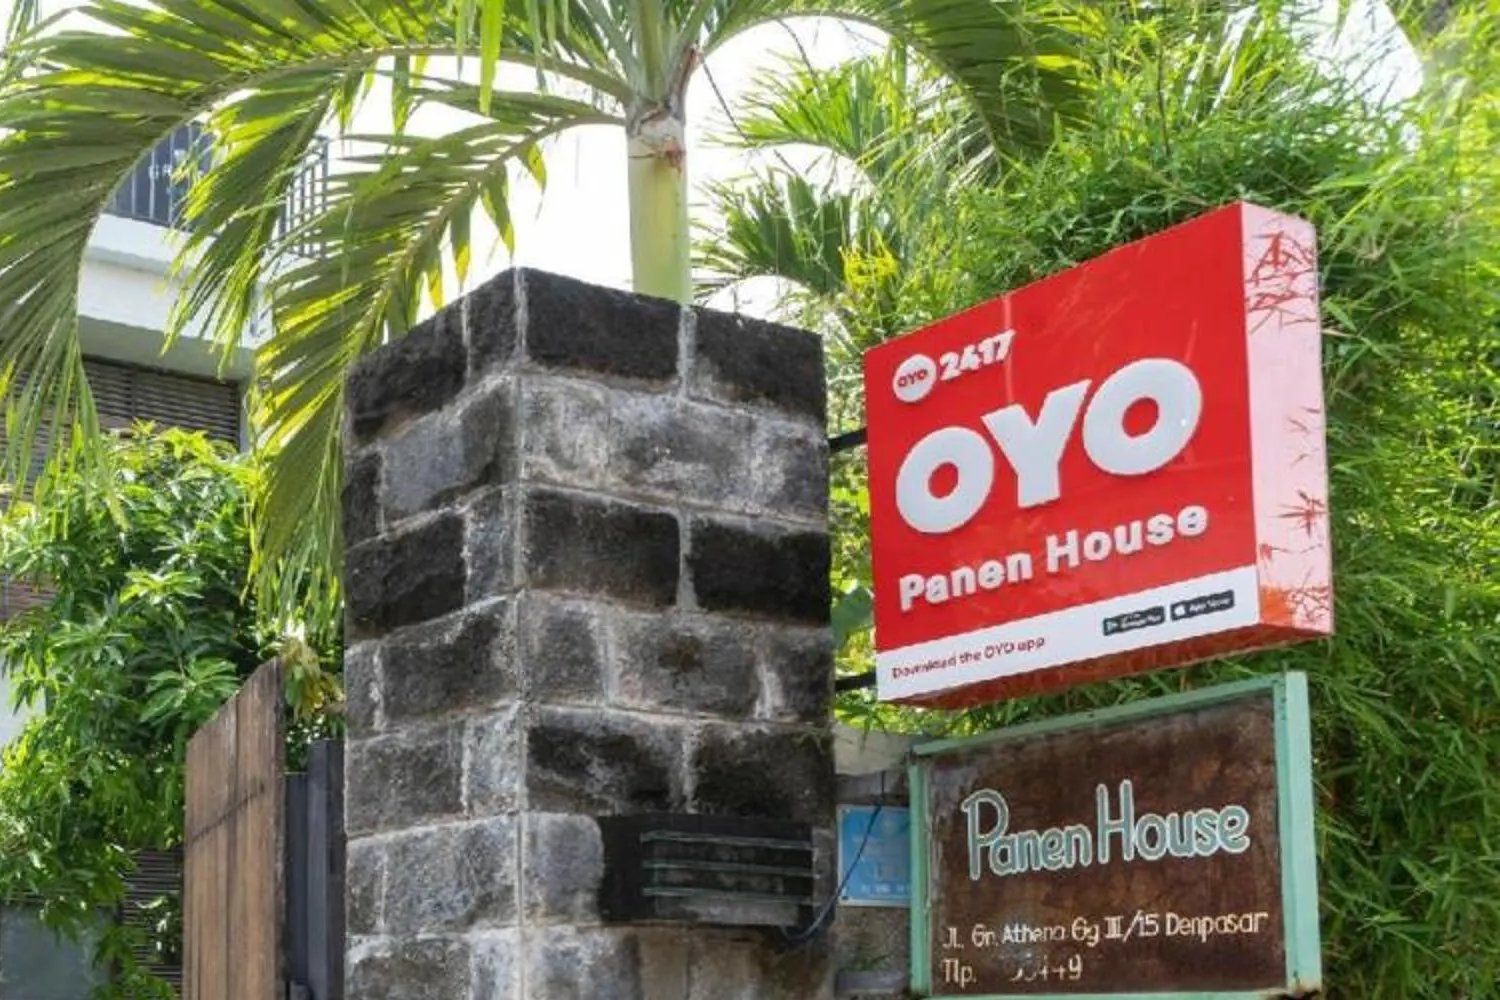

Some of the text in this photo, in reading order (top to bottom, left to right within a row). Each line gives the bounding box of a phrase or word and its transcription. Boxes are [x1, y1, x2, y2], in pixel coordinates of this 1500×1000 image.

[897, 329, 1016, 387] OYO 2417
[896, 358, 1202, 533] OYO
[899, 505, 1209, 612] Panen House
[959, 649, 982, 664] the
[984, 642, 1014, 659] OYO
[1017, 637, 1046, 653] app
[961, 779, 1251, 880] Panen House
[1002, 921, 1066, 945] Athena
[1071, 916, 1099, 947] Gg
[1165, 912, 1269, 943] Denpasar
